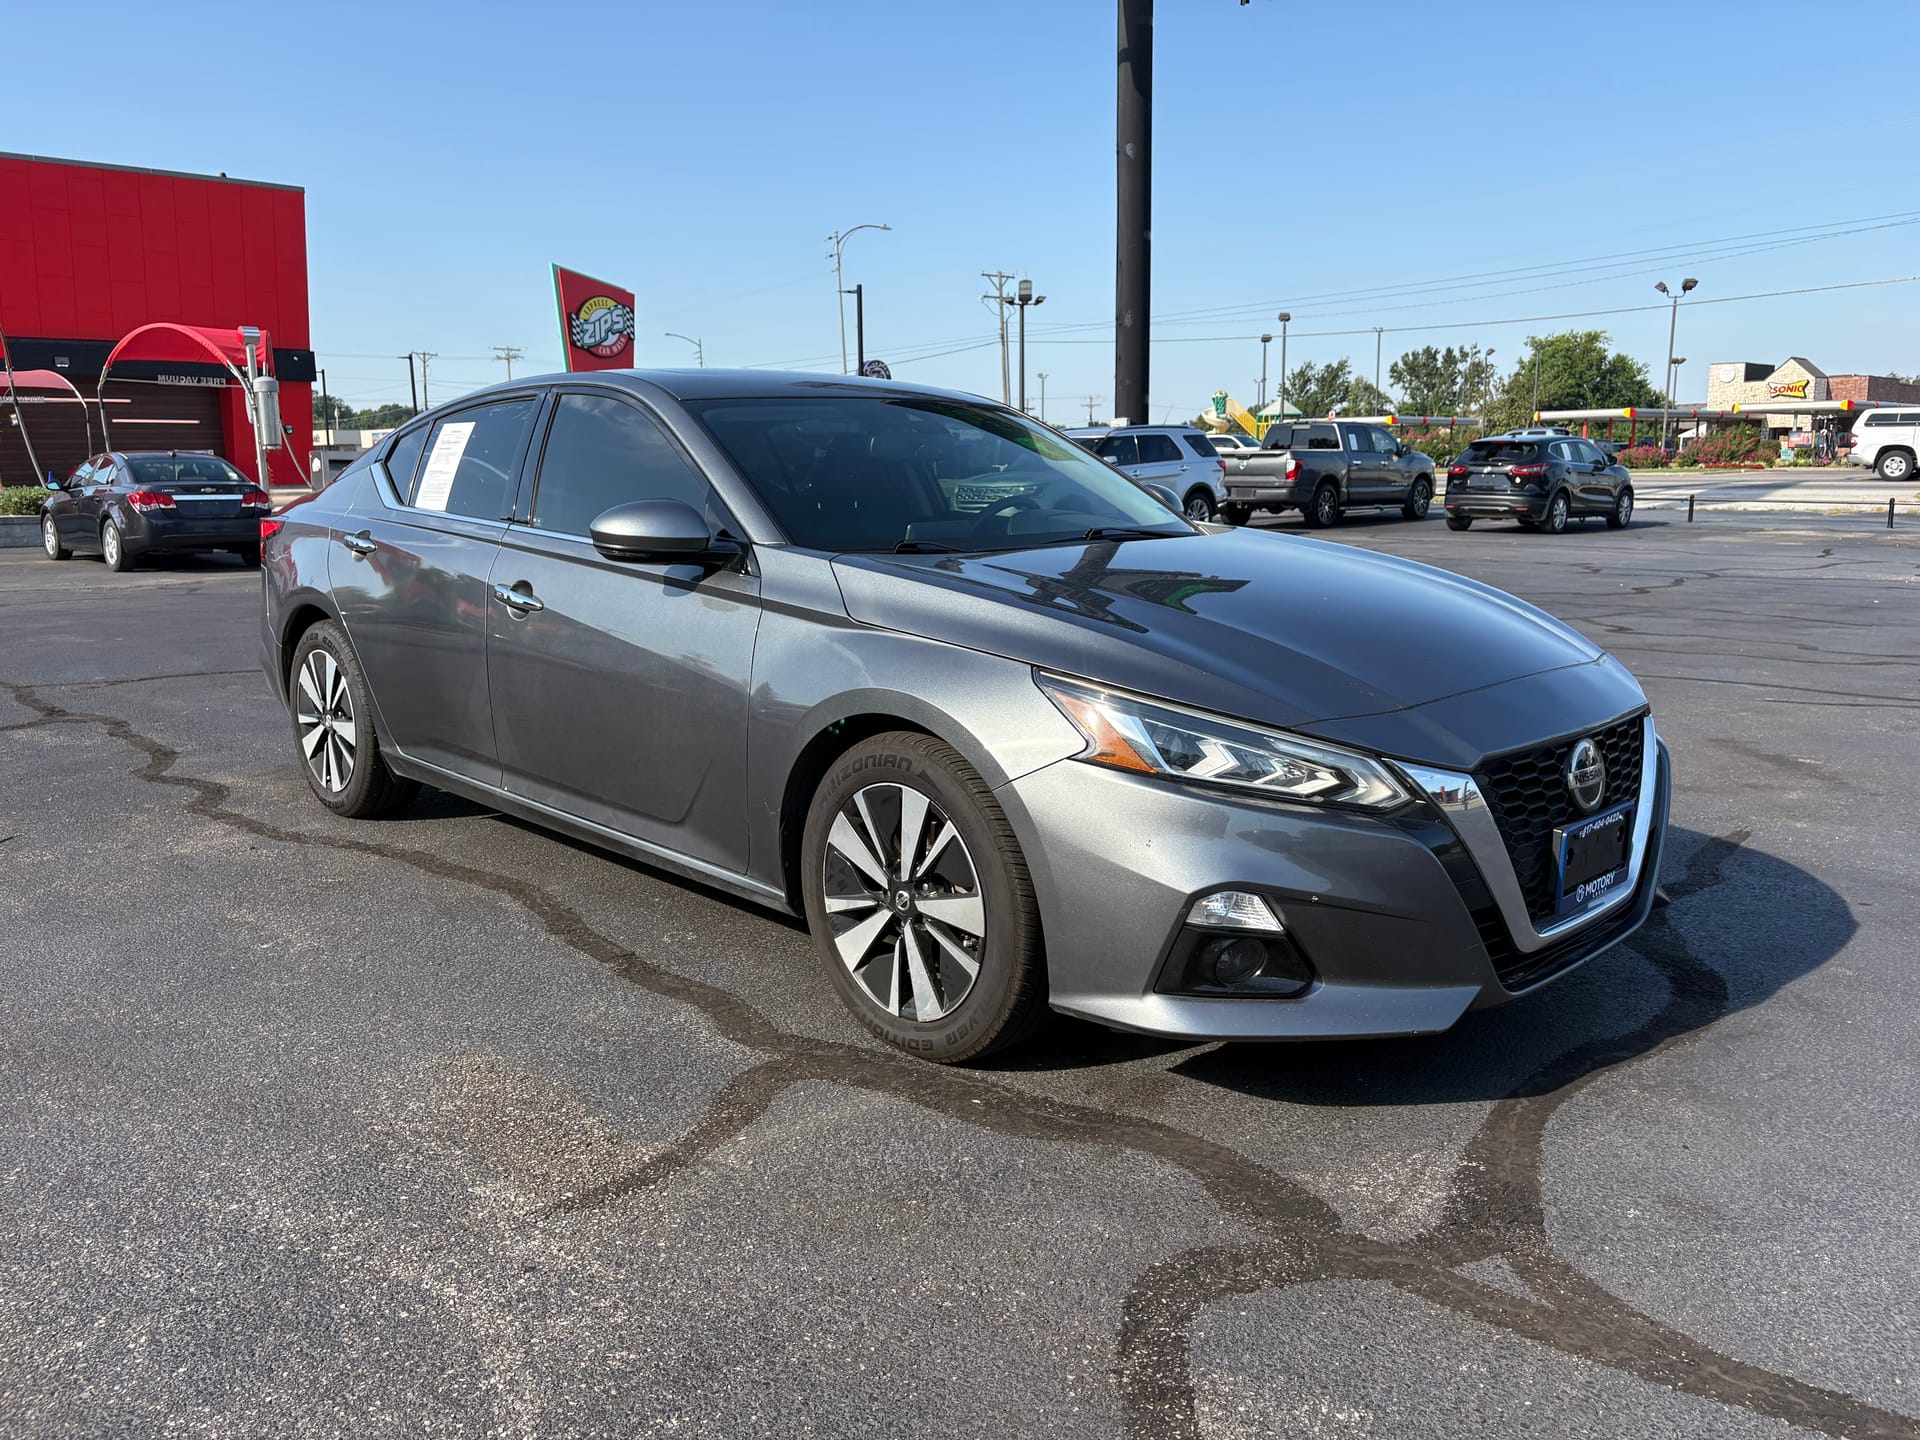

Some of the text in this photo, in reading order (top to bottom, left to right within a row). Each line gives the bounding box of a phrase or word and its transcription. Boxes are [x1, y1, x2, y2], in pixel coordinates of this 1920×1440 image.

[583, 299, 609, 316] EXPRESS
[583, 308, 624, 344] ZIPS
[598, 345, 611, 356] CAR
[1771, 385, 1804, 394] SONIC
[1574, 767, 1602, 785] NISSAN
[1585, 871, 1616, 896] MOTORY
